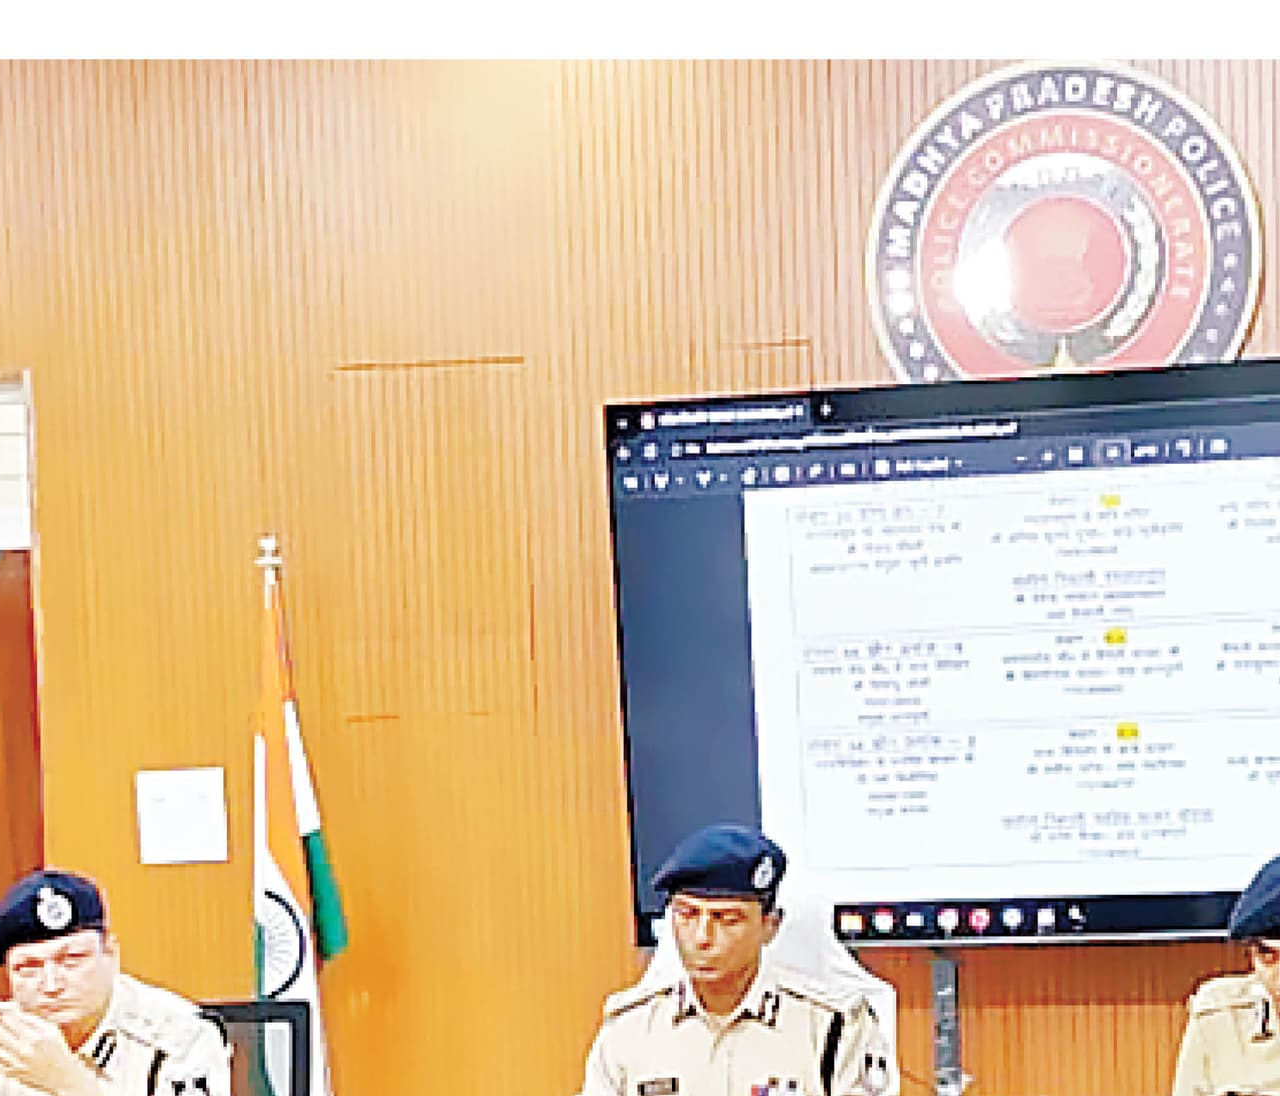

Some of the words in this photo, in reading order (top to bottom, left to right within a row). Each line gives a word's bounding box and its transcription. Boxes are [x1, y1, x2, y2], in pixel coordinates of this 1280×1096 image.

[885, 110, 983, 256] MADHYA
[984, 76, 1163, 122] PRADESH
[1163, 115, 1242, 238] POLICE
[965, 124, 1196, 300] COMMISSIONERATE
